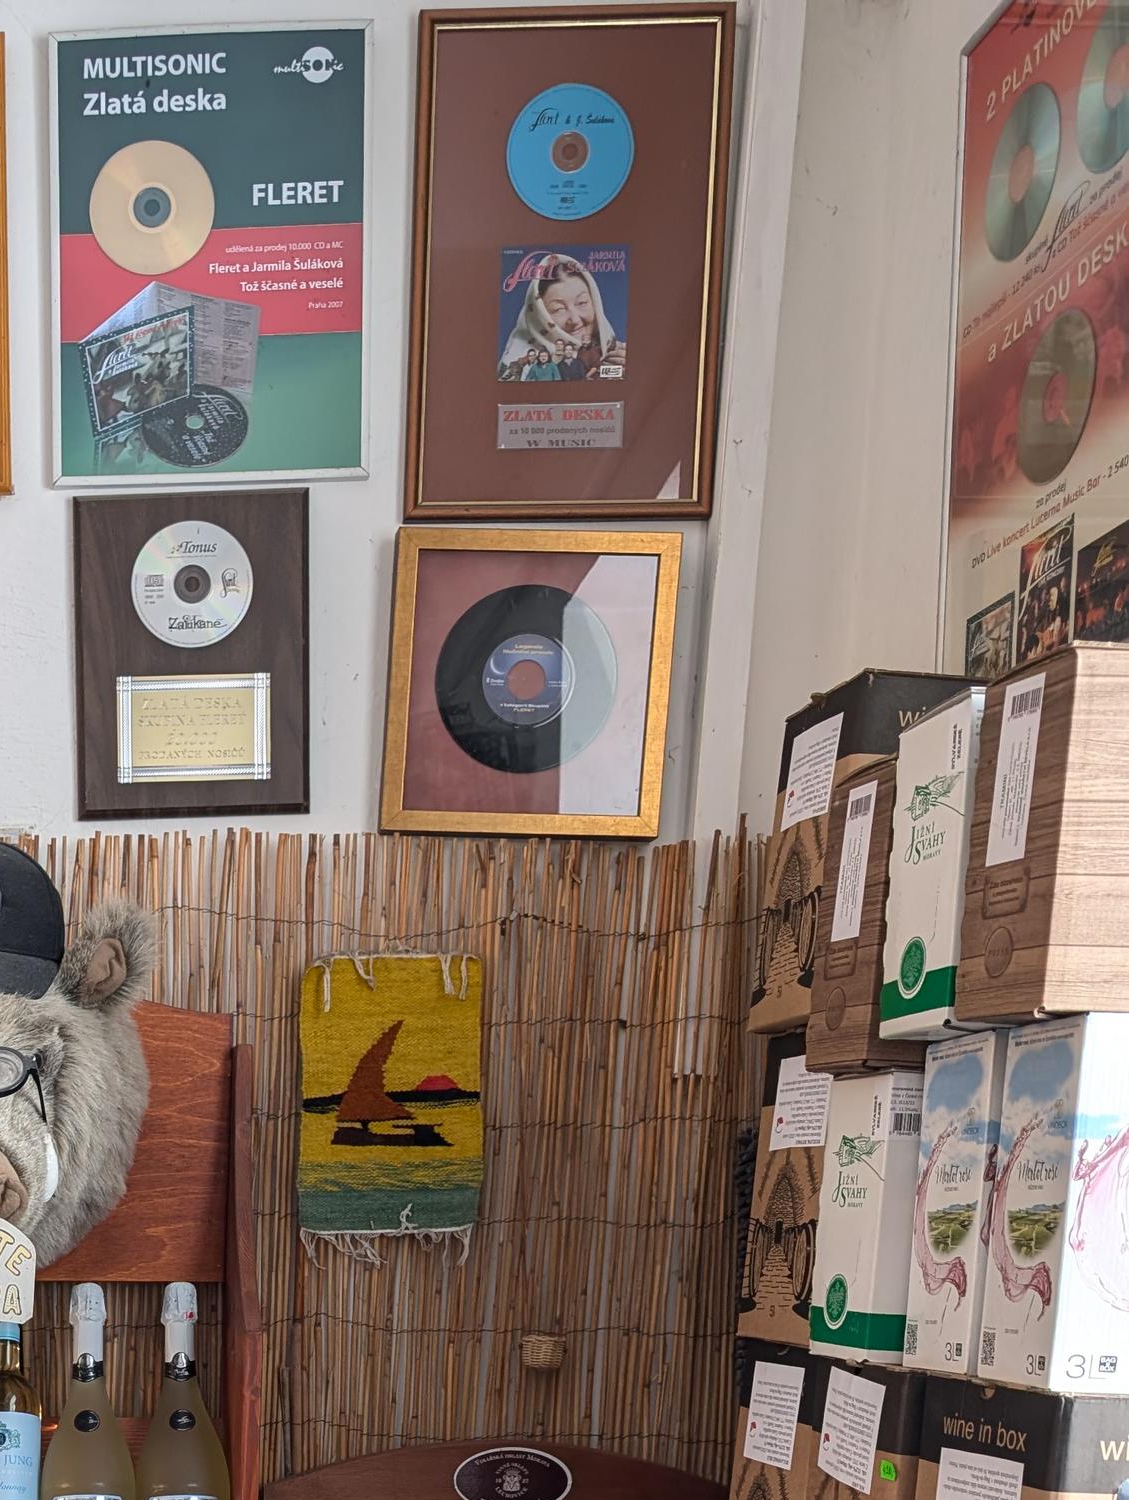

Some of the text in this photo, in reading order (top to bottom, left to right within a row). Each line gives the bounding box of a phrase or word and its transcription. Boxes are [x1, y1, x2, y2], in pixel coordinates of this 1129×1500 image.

[83, 53, 226, 79] MULTISONIC
[83, 88, 226, 116] Zlatá deska
[987, 91, 995, 121] 2
[253, 181, 344, 206] FLERET
[264, 244, 286, 252] prodej
[209, 263, 240, 274] Fleret
[251, 261, 291, 272] Jarmila
[294, 258, 343, 270] Šuláková
[240, 278, 343, 292] Tož ščasné a veselé
[308, 301, 326, 309] Praha
[988, 343, 996, 362] a
[1002, 272, 1069, 350] ZLATOU
[503, 407, 615, 422] ZLATÁ DESKA
[526, 439, 596, 448] W MUSIC
[972, 476, 1100, 568] DVD Live koncert Lucerna Music Bar
[181, 541, 217, 553] Tonus
[904, 821, 935, 863] JIŽNÍ
[913, 831, 945, 865] SVAHY
[1100, 1365, 1115, 1373] BOX
[943, 1413, 1028, 1452] wine in box
[4, 1454, 32, 1467] JUNG
